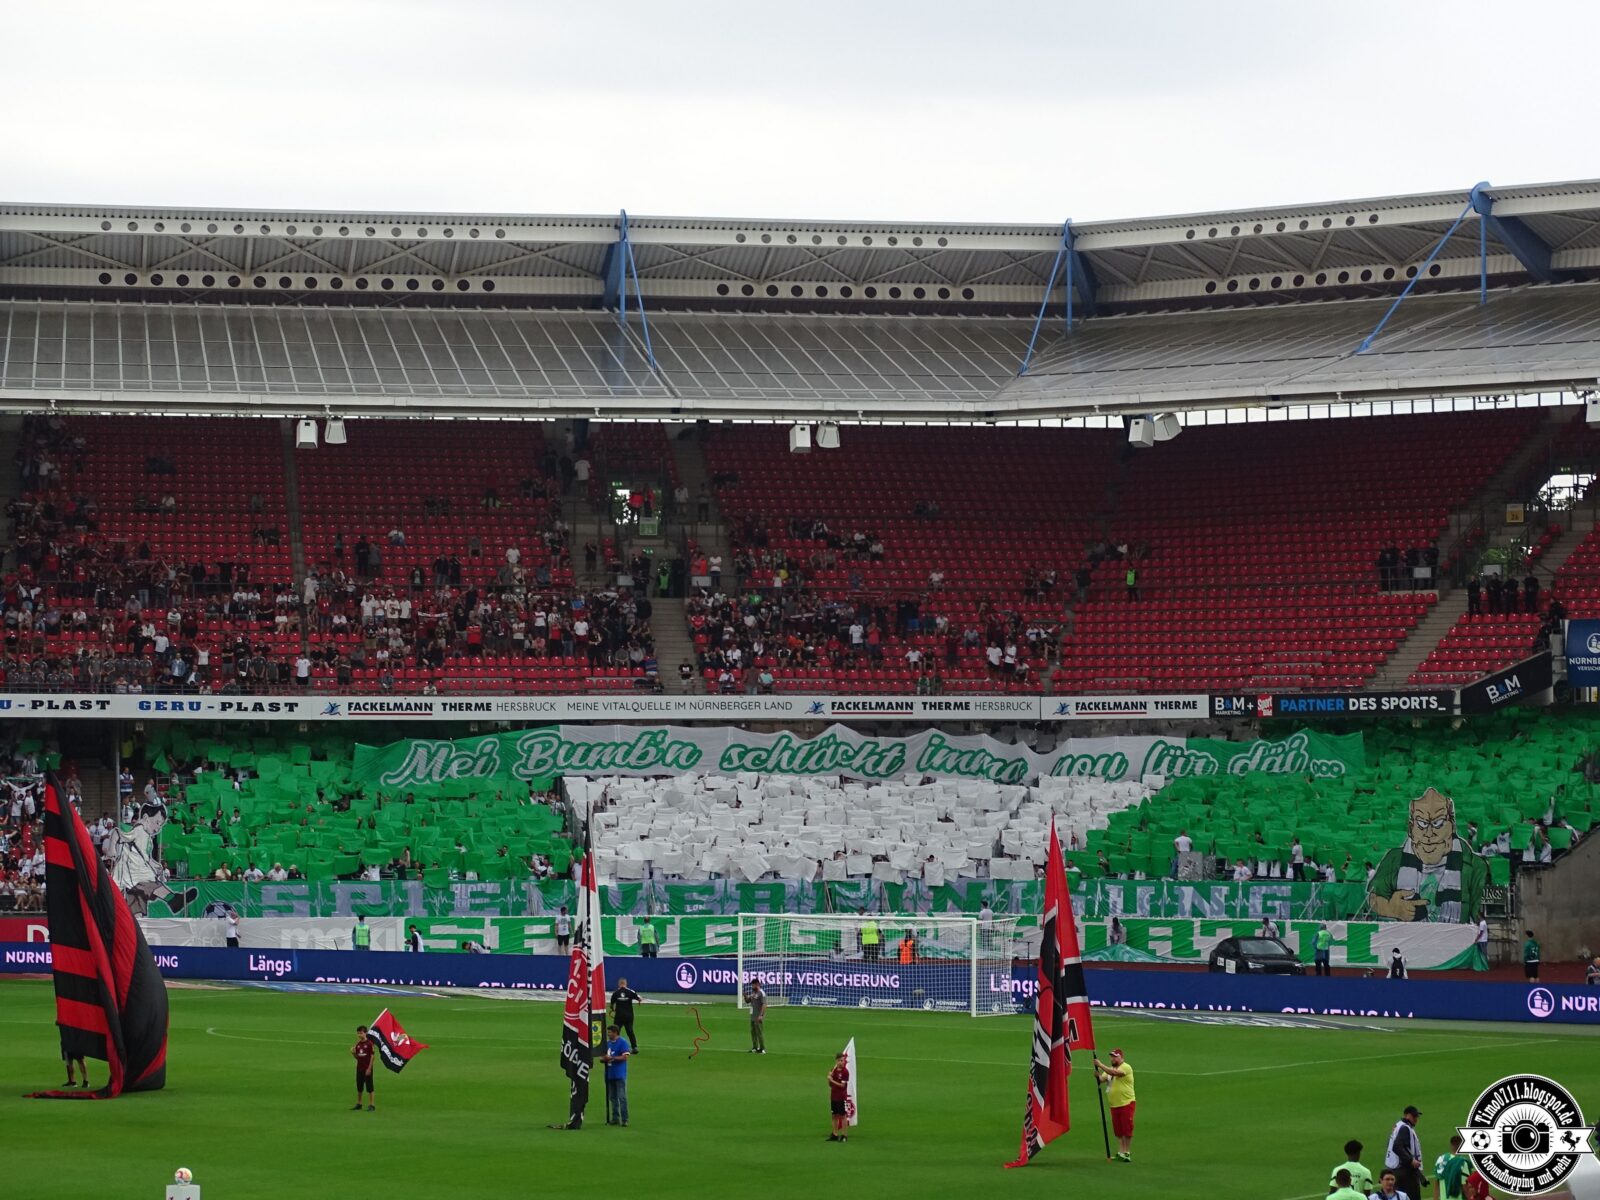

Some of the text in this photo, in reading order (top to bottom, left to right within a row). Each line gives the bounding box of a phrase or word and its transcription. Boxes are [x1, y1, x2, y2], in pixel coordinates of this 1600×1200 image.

[1485, 674, 1521, 700] B&M
[347, 699, 793, 713] FACKELMANN THERME HERSBRUCK MEINE VITALQUELLE IM NÜRNBERGER LAND
[831, 702, 1033, 711] FACKELMANN THERME HERSBRUCK
[1075, 700, 1198, 712] FACKELMANN THERME
[1215, 696, 1245, 711] B&M
[1280, 699, 1345, 712] PARTNER
[1349, 697, 1377, 711] DES
[382, 738, 499, 786] Mei
[5, 950, 53, 964] NÜRNB
[249, 954, 292, 977] Längs
[702, 968, 901, 989] NÜRNBERGER VERSICHERUNG
[989, 973, 1040, 996] Längs
[1561, 995, 1600, 1012] NÜR
